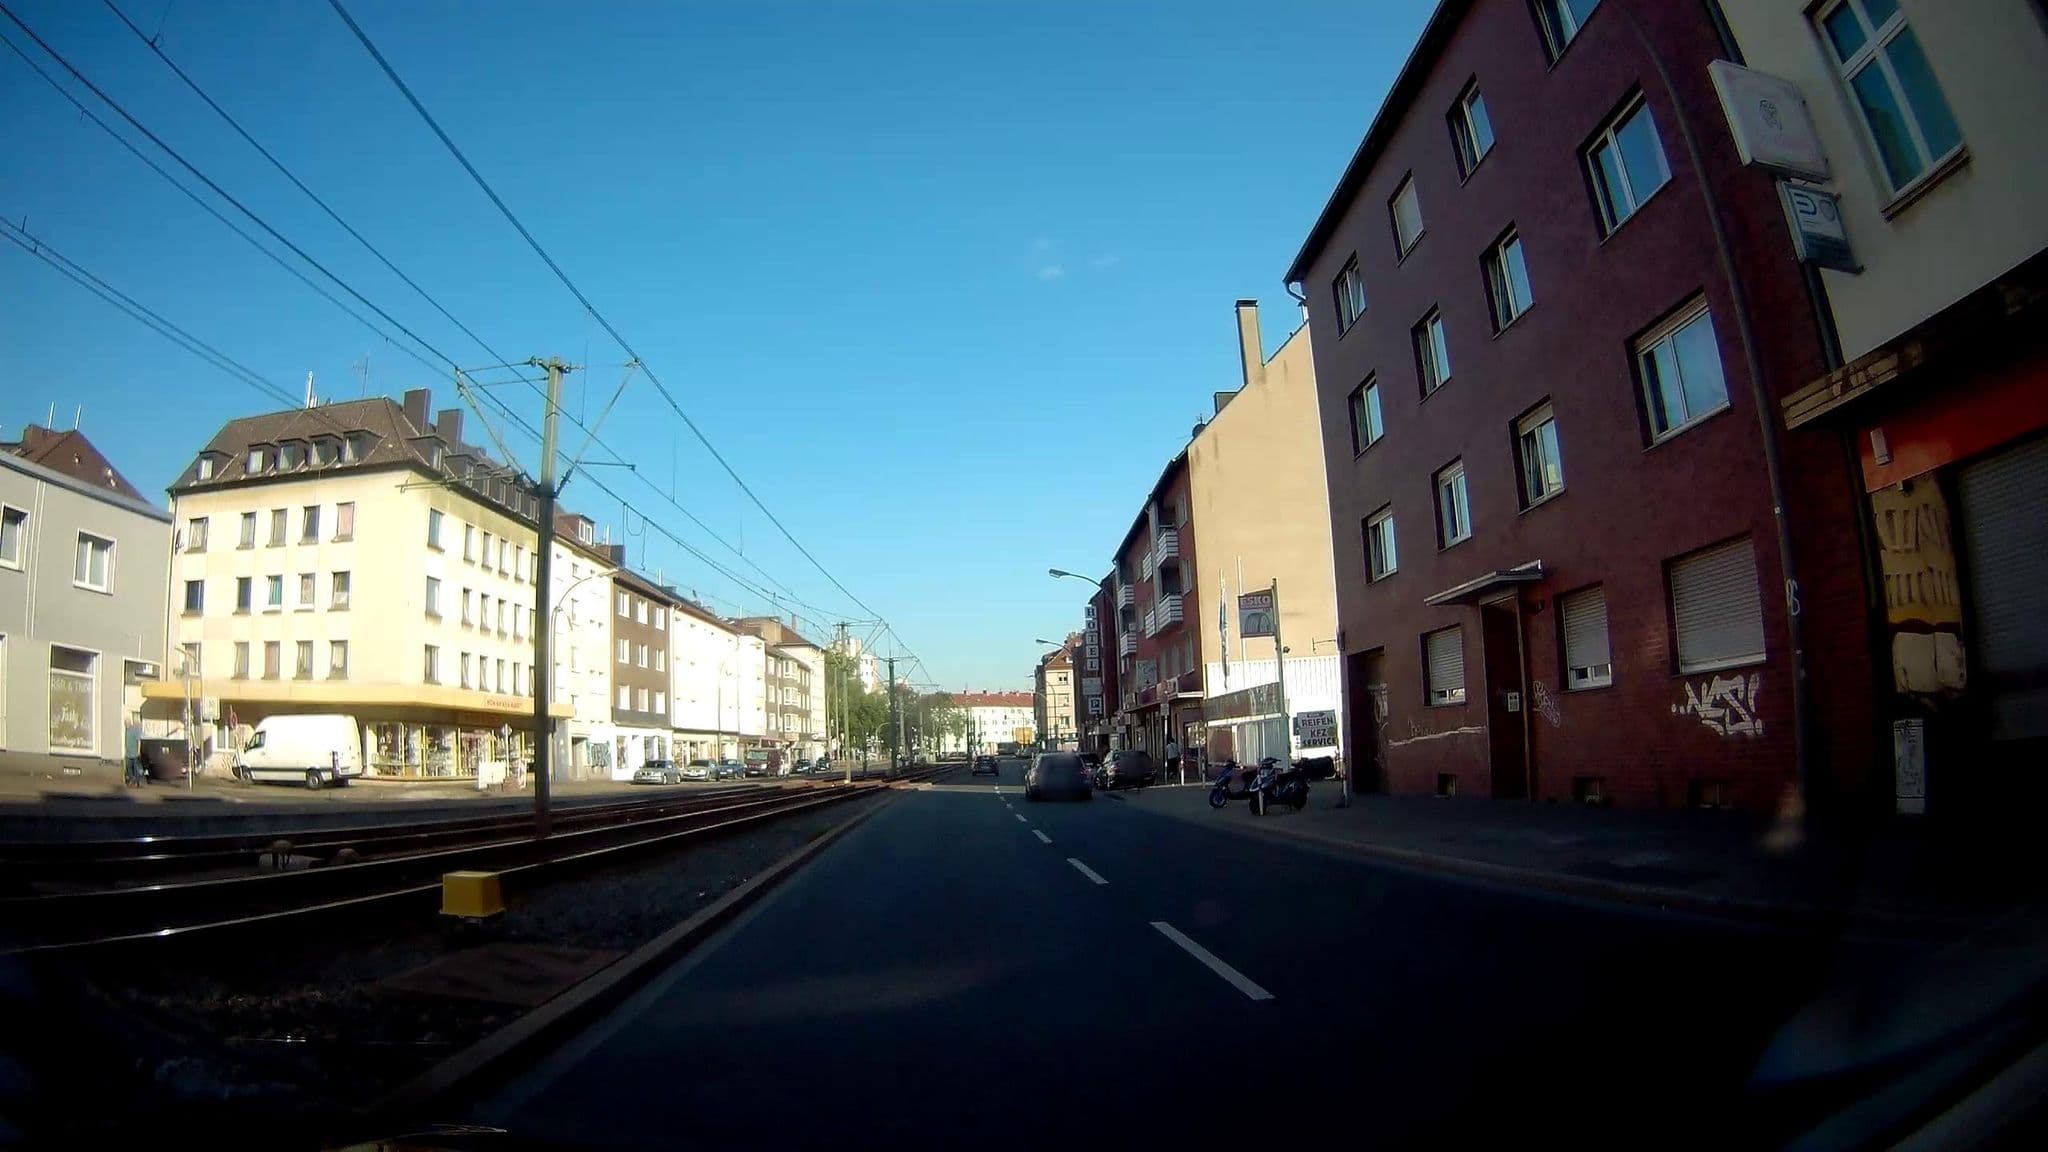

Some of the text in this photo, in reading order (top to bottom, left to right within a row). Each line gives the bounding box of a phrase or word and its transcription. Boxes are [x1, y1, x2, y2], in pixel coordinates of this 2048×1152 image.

[1087, 608, 1099, 668] HOTEL
[1302, 715, 1333, 726] REIFEN
[1310, 728, 1327, 738] KFZ
[1301, 737, 1336, 745] SERVICE
